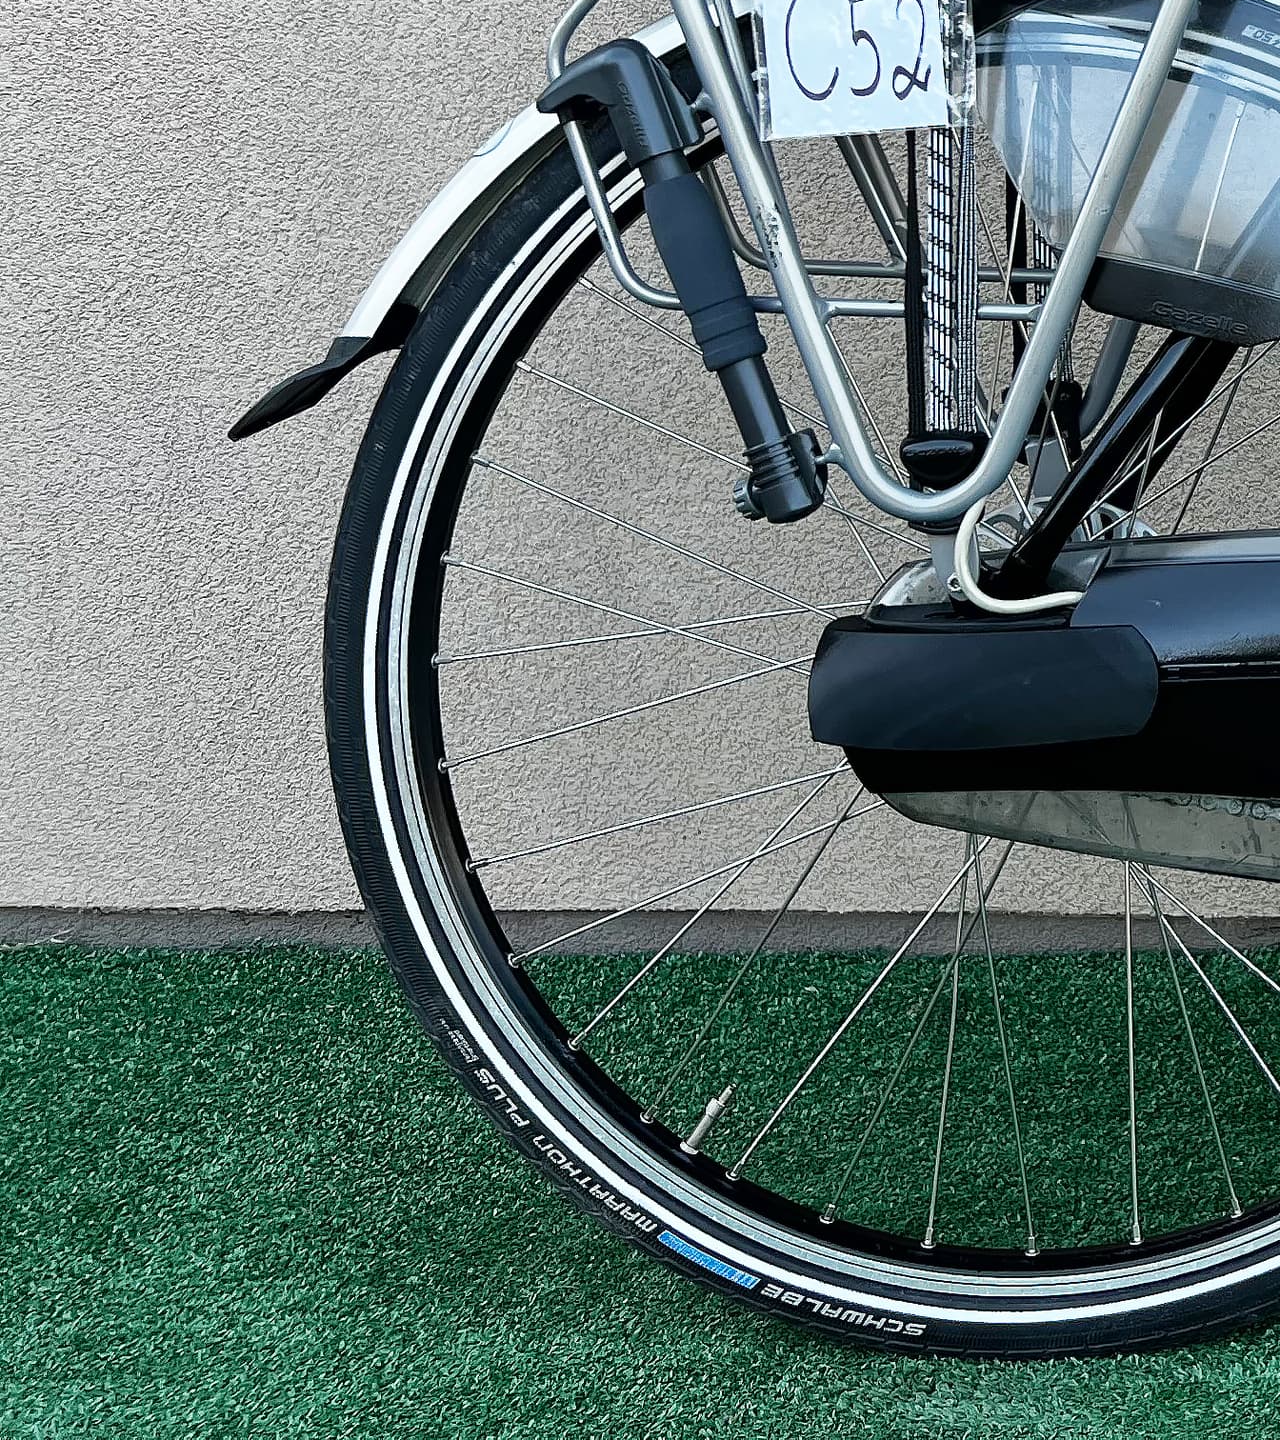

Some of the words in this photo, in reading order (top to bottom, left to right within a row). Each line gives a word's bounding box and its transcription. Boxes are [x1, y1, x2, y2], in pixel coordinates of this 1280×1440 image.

[473, 1067, 531, 1128] PLUS
[532, 1134, 659, 1233] MARATHON
[759, 1282, 928, 1337] SCHWALBE
